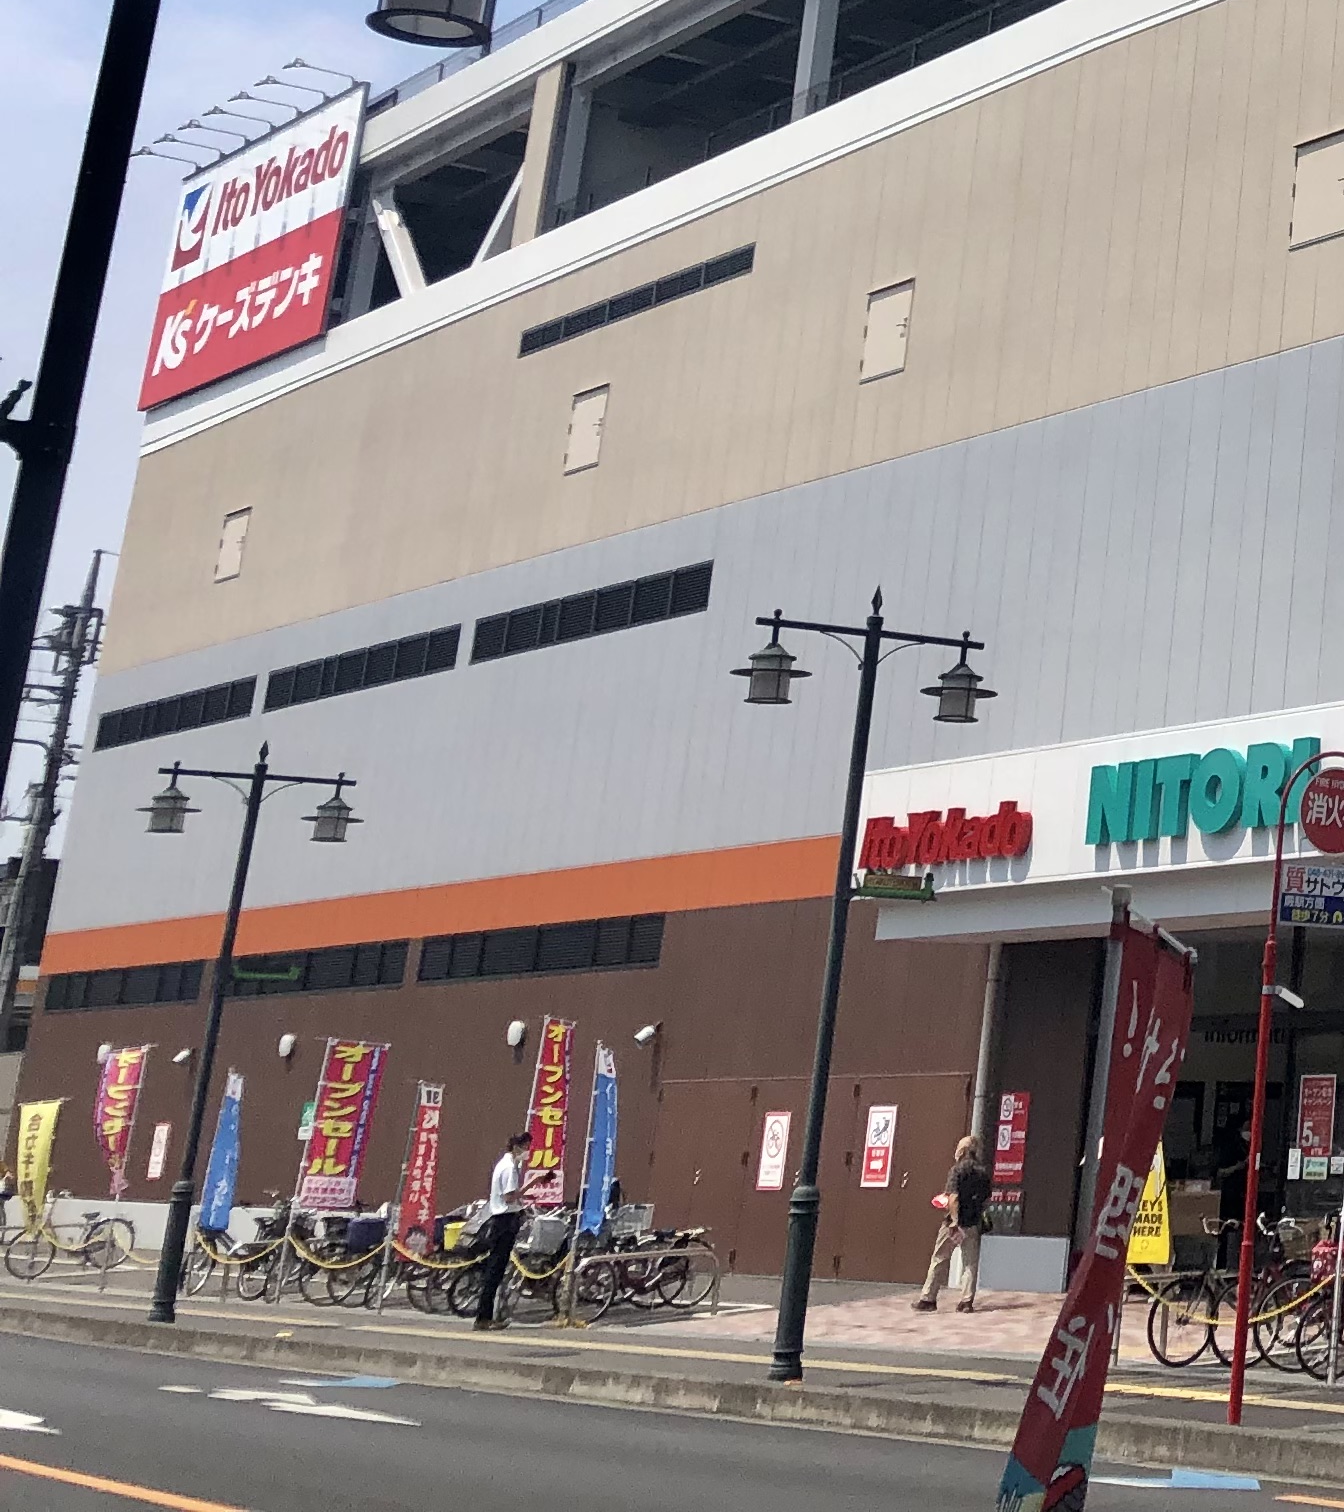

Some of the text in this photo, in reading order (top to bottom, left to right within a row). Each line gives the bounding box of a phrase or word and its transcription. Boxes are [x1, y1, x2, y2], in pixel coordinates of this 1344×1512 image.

[192, 251, 324, 355] ケーズデンキ
[1085, 736, 1321, 846] NITORI
[1315, 777, 1331, 788] FIRE
[1285, 866, 1306, 893] 質
[306, 1044, 374, 1177] オープンセール
[528, 1024, 567, 1170] オープンセール
[1132, 1225, 1162, 1237] HERE
[1141, 1199, 1164, 1212] EYS
